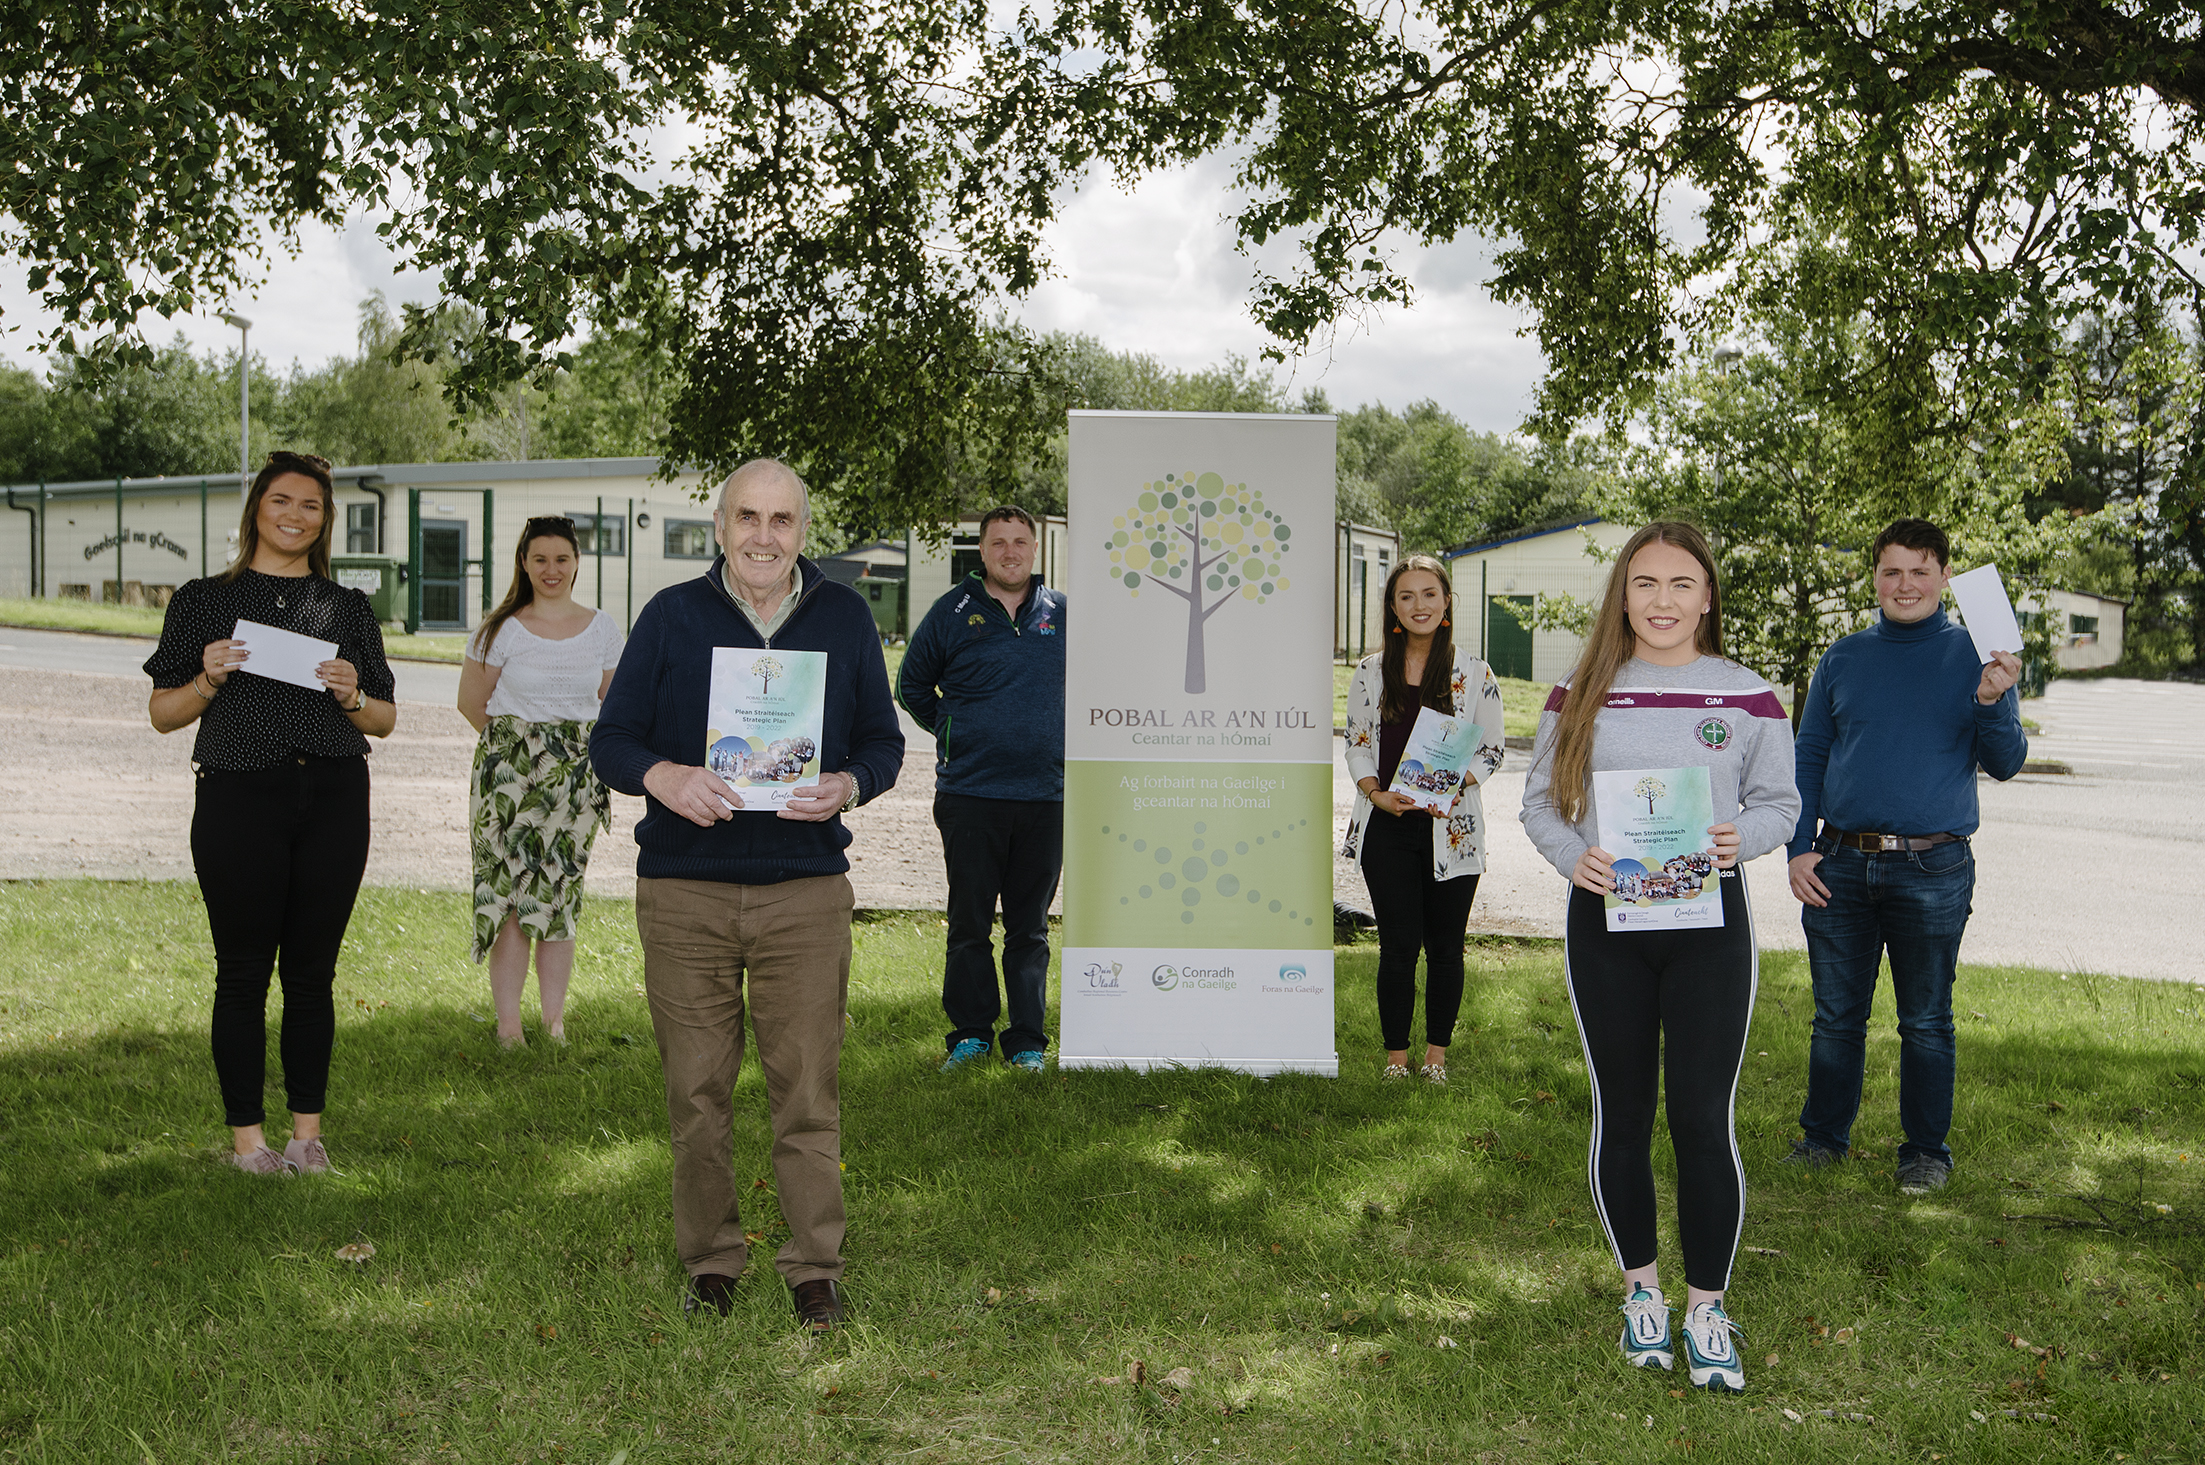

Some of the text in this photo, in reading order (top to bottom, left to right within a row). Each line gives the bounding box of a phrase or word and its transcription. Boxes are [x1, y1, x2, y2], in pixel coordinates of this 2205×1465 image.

[133, 531, 146, 543] na
[149, 531, 188, 560] gCrann
[1704, 697, 1724, 706] GM
[1089, 706, 1317, 730] POBAL AR A'N IÚL
[1132, 731, 1272, 746] Ceantar na hÓmaí
[1120, 775, 1286, 794] Ag forbairt na Gaeilge i
[1133, 794, 1271, 811] gceantar na hÓmaí
[1643, 828, 1686, 836] Straitéiseach
[1720, 870, 1736, 878] das
[1182, 966, 1234, 978] Conradh
[1182, 978, 1237, 991] na Gaeilge
[1262, 985, 1282, 993] Foras
[1295, 985, 1324, 995] Gaeilge
